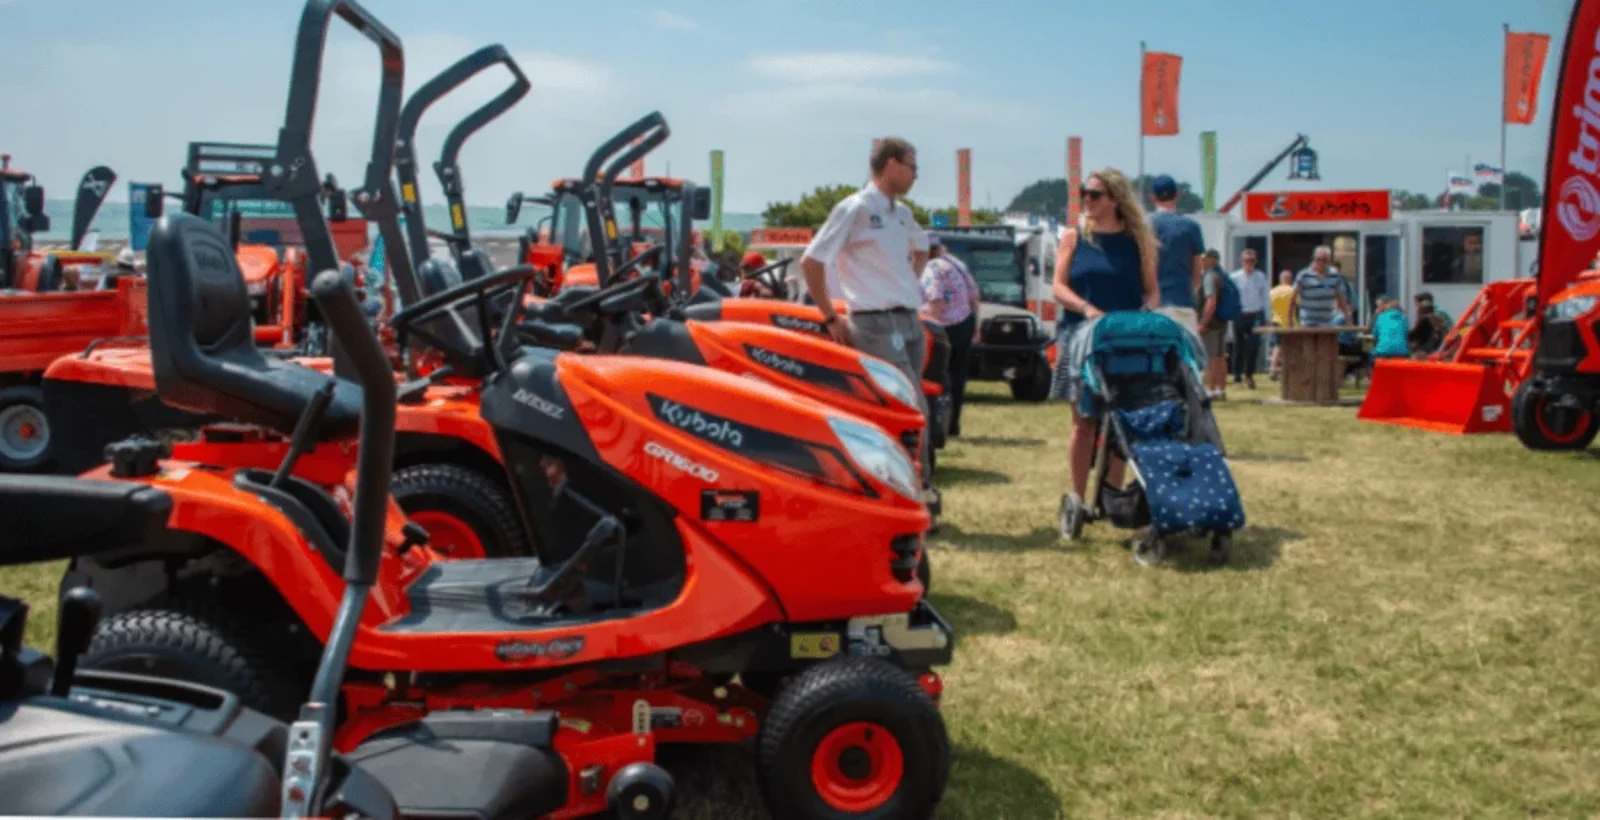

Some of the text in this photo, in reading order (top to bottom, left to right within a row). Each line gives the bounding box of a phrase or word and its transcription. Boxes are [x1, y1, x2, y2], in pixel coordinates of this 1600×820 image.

[1298, 199, 1372, 216] Kubota
[751, 347, 805, 376] Kubota
[660, 400, 743, 447] Kubota
[644, 441, 719, 483] GR1600
